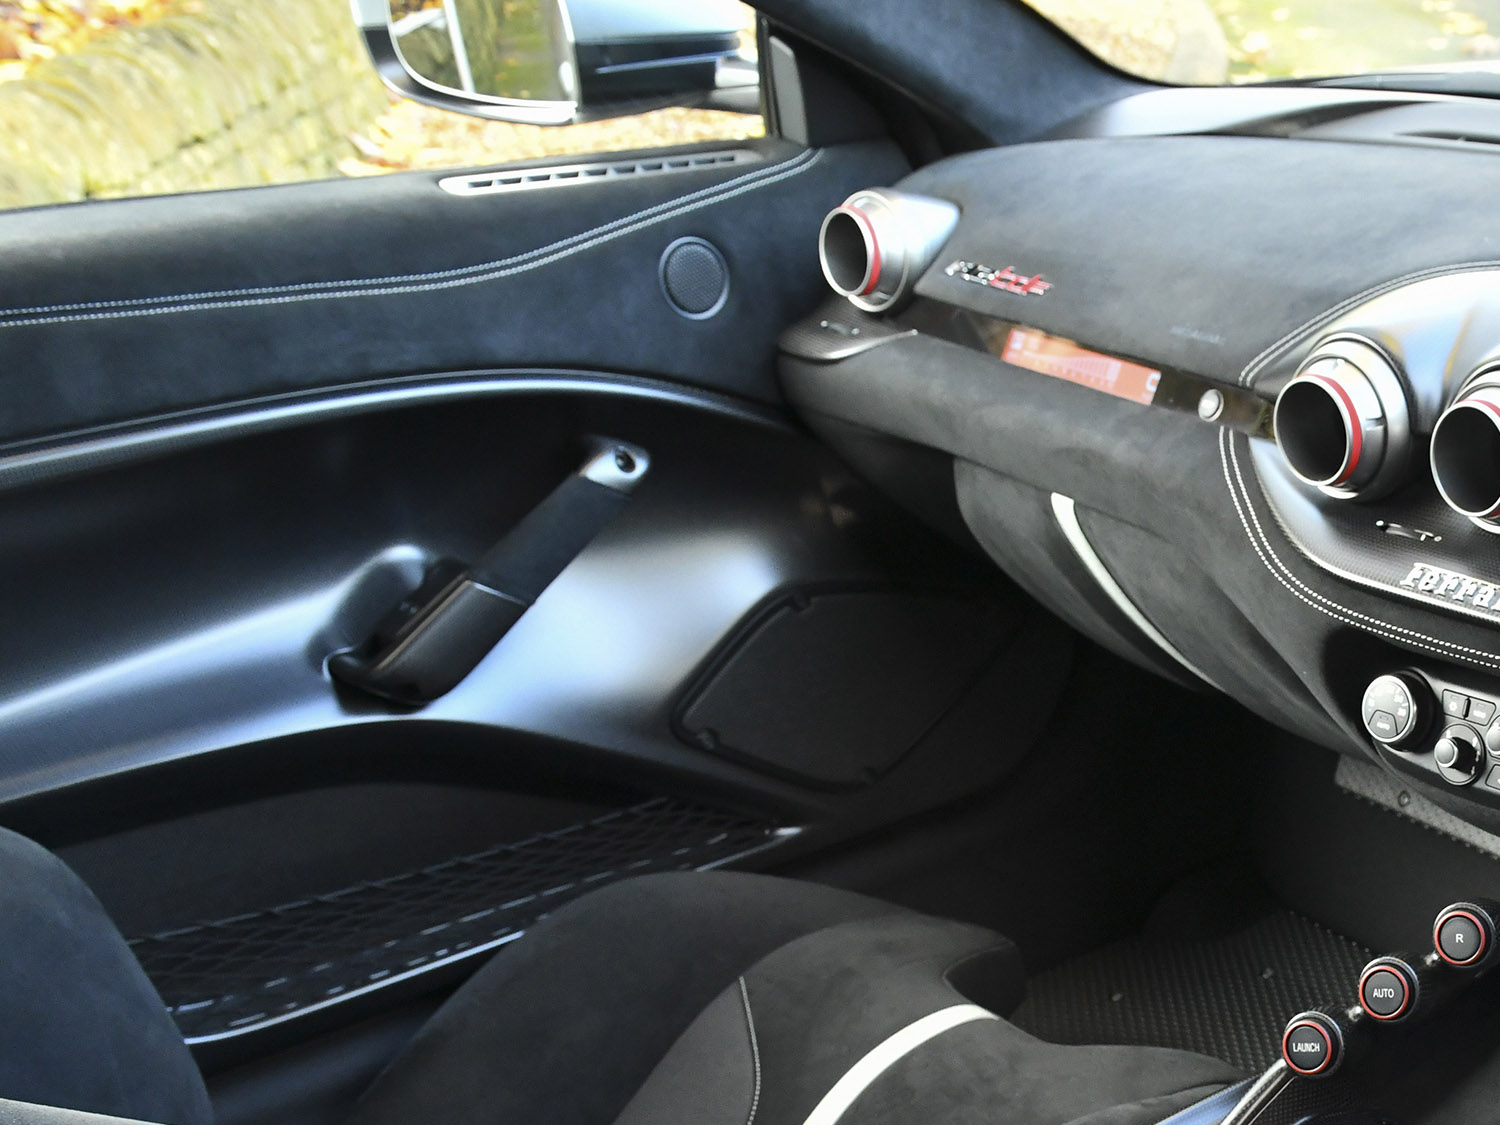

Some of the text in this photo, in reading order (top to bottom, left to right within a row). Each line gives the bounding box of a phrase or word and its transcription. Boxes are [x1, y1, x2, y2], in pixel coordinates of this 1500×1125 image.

[1454, 933, 1464, 943] R
[1372, 987, 1394, 999] AUTO
[1292, 1042, 1320, 1053] LAUNCH
